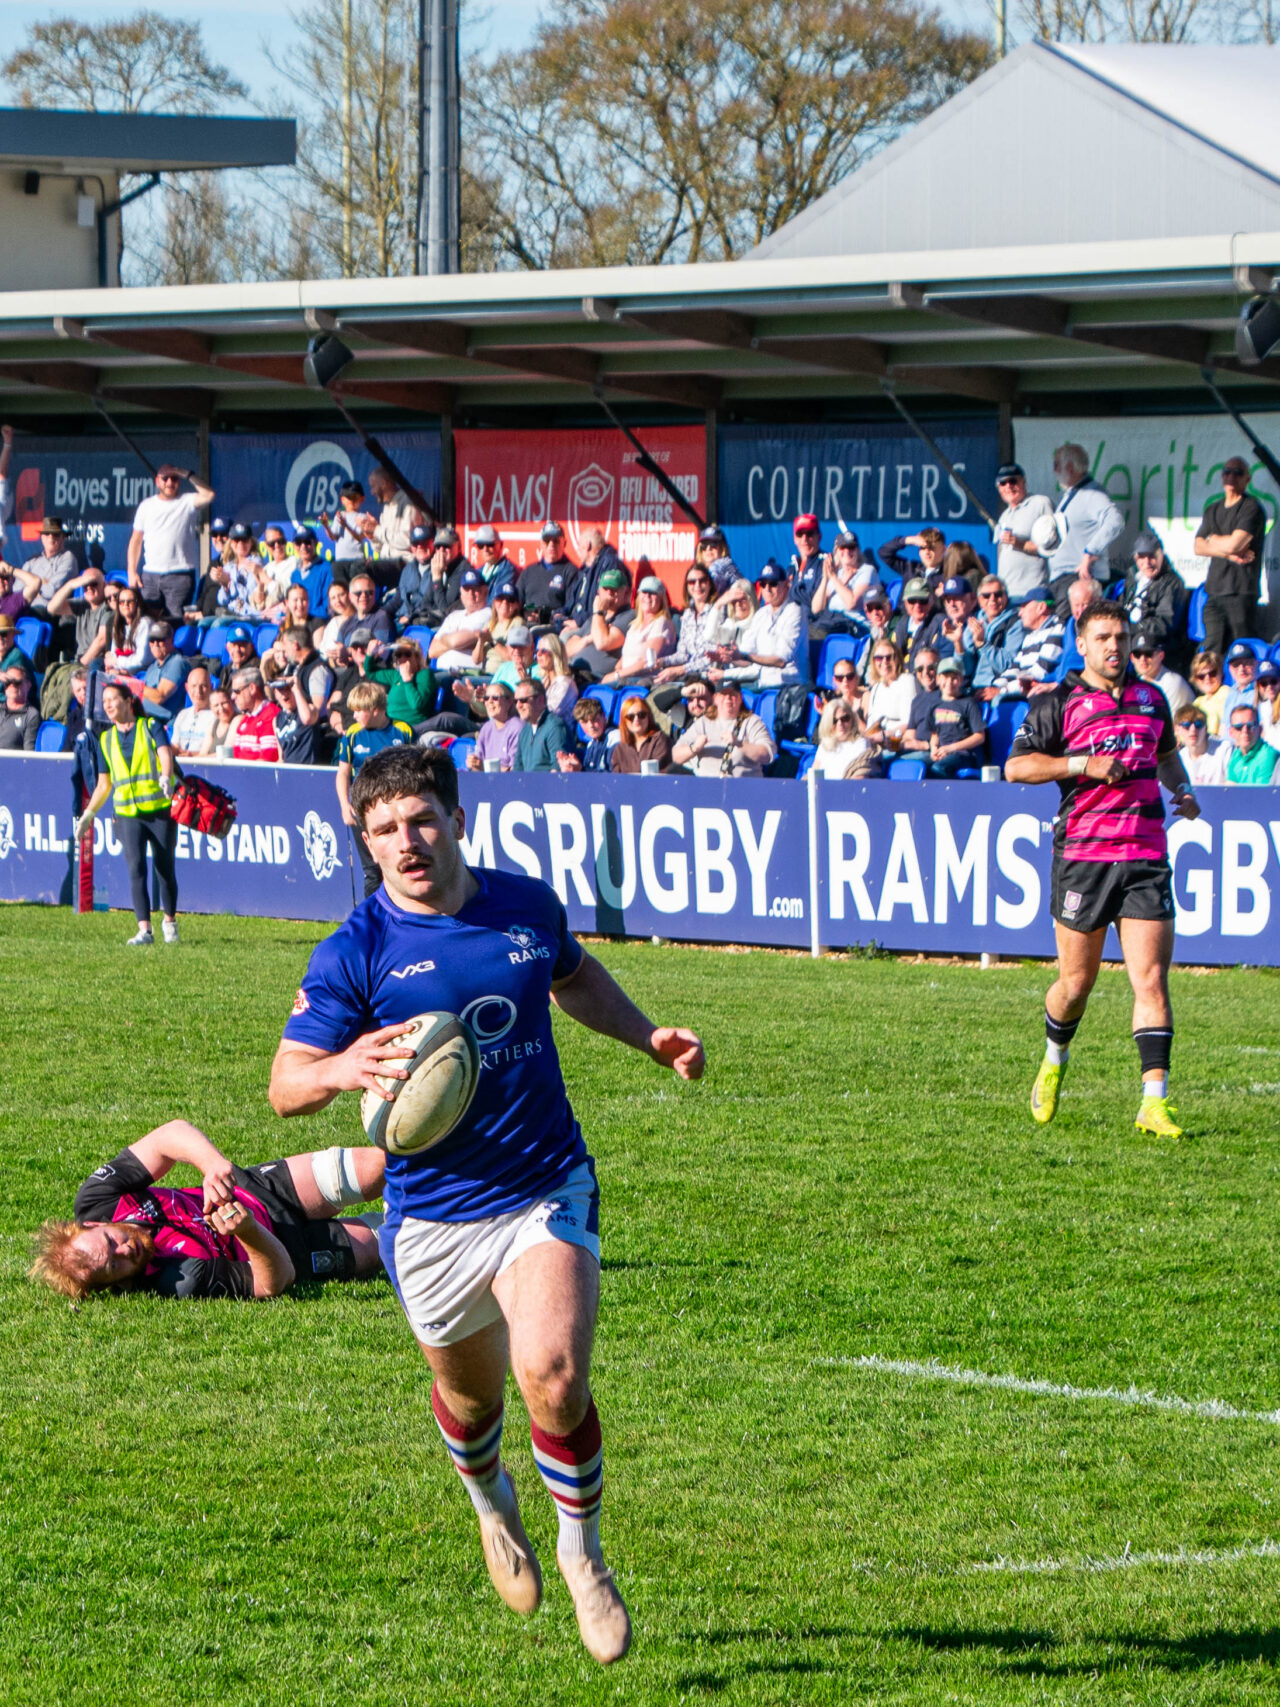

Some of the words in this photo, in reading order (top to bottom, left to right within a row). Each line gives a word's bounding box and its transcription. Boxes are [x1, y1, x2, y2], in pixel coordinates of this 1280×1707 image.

[54, 467, 110, 515] Boyes
[111, 466, 156, 507] Turn
[305, 475, 341, 513] IBS
[470, 473, 548, 523] RAMS
[620, 475, 643, 503] RFU
[747, 462, 969, 530] COURTIERS
[619, 504, 673, 532] PLAYERS
[618, 531, 695, 562] FOUNDATION
[507, 946, 551, 965] RAMS
[479, 1038, 543, 1070] RTIERS
